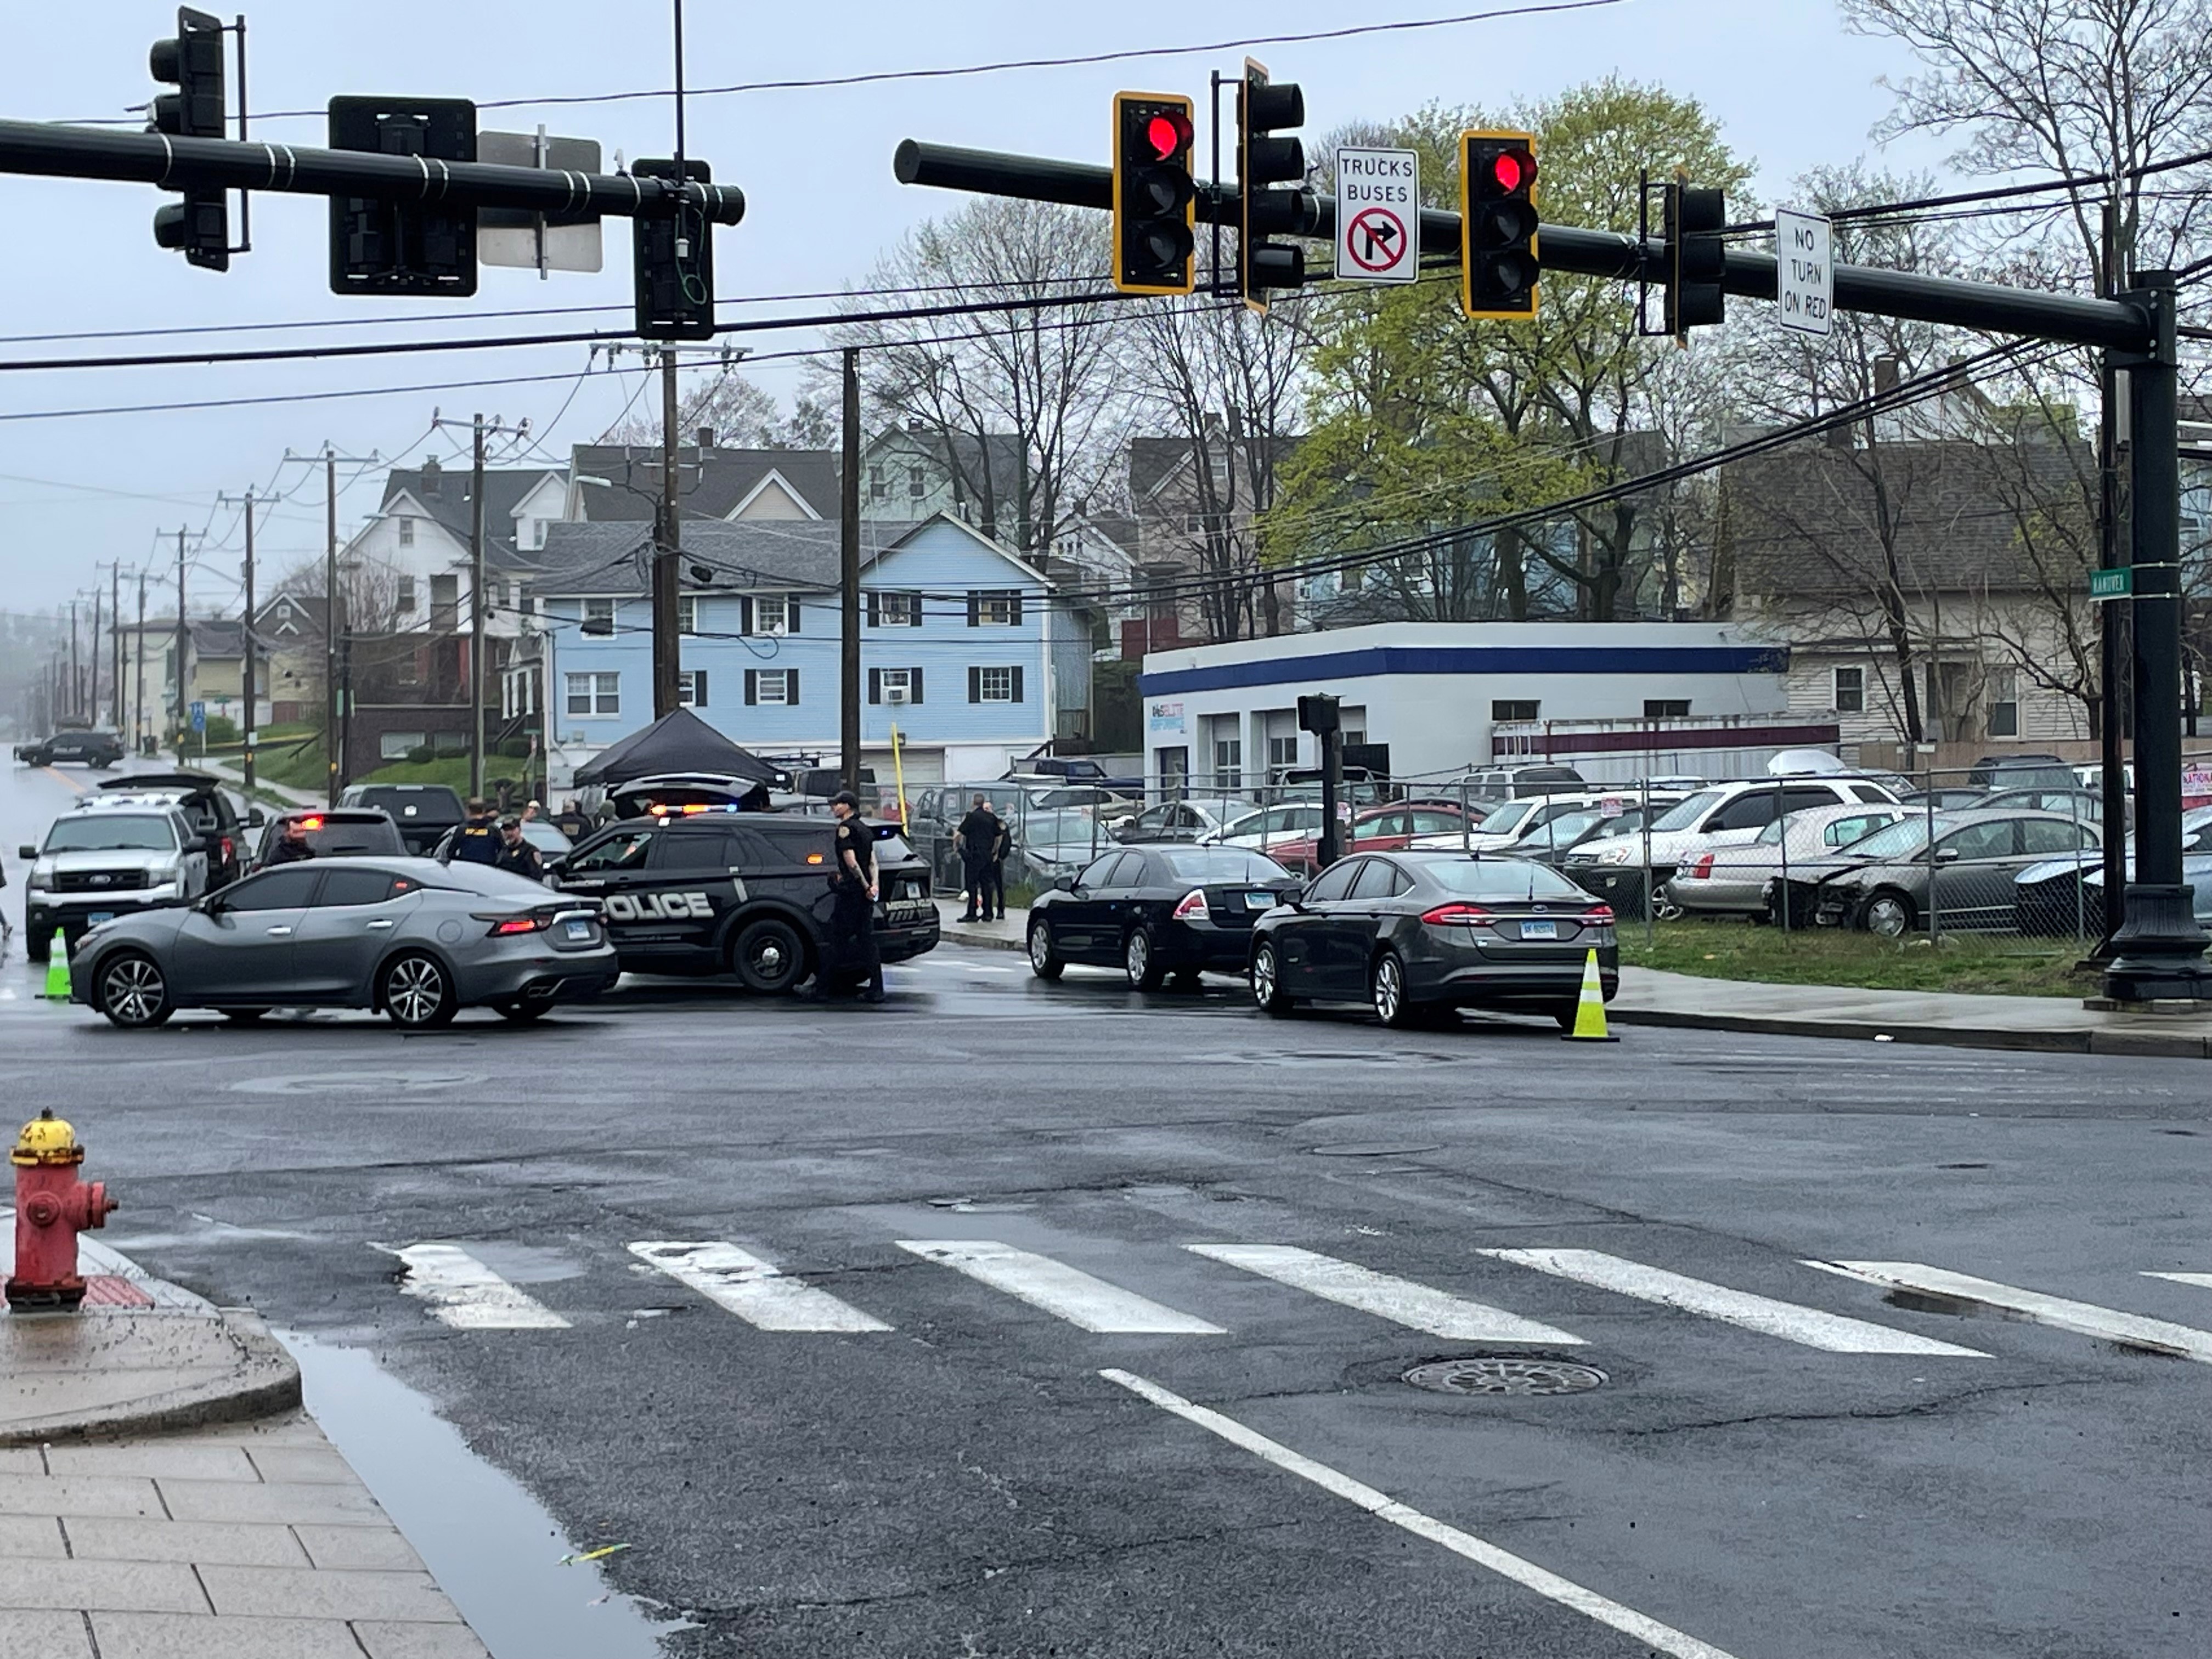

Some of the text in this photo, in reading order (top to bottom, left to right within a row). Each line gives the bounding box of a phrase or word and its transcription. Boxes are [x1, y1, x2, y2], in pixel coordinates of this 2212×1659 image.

[1342, 157, 1413, 177] TRUCKS
[1347, 184, 1408, 202] BUSES
[1795, 227, 1814, 251] NO
[1791, 258, 1822, 285] TURN
[1785, 290, 1826, 319] ON RED
[2183, 772, 2212, 784] NATION
[601, 893, 714, 920] OLICE
